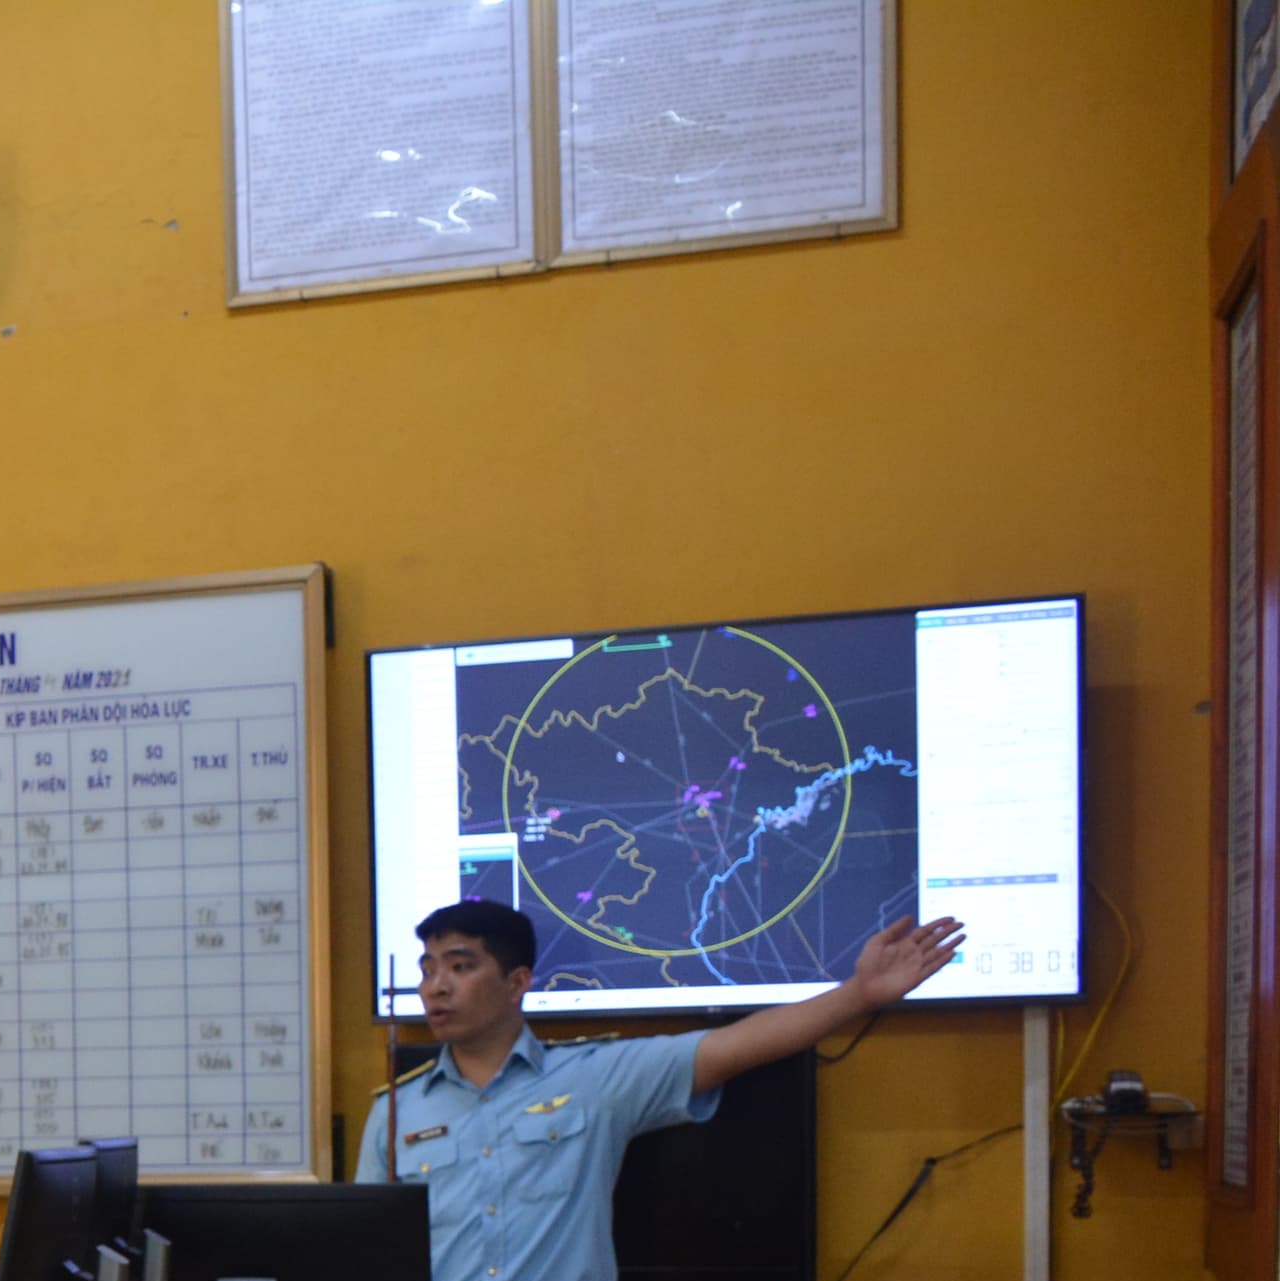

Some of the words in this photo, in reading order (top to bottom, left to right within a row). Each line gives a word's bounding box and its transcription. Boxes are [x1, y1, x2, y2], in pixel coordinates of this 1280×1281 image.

[0, 674, 41, 696] THÁNG
[29, 709, 58, 727] BAN
[1008, 951, 1033, 974] 38
